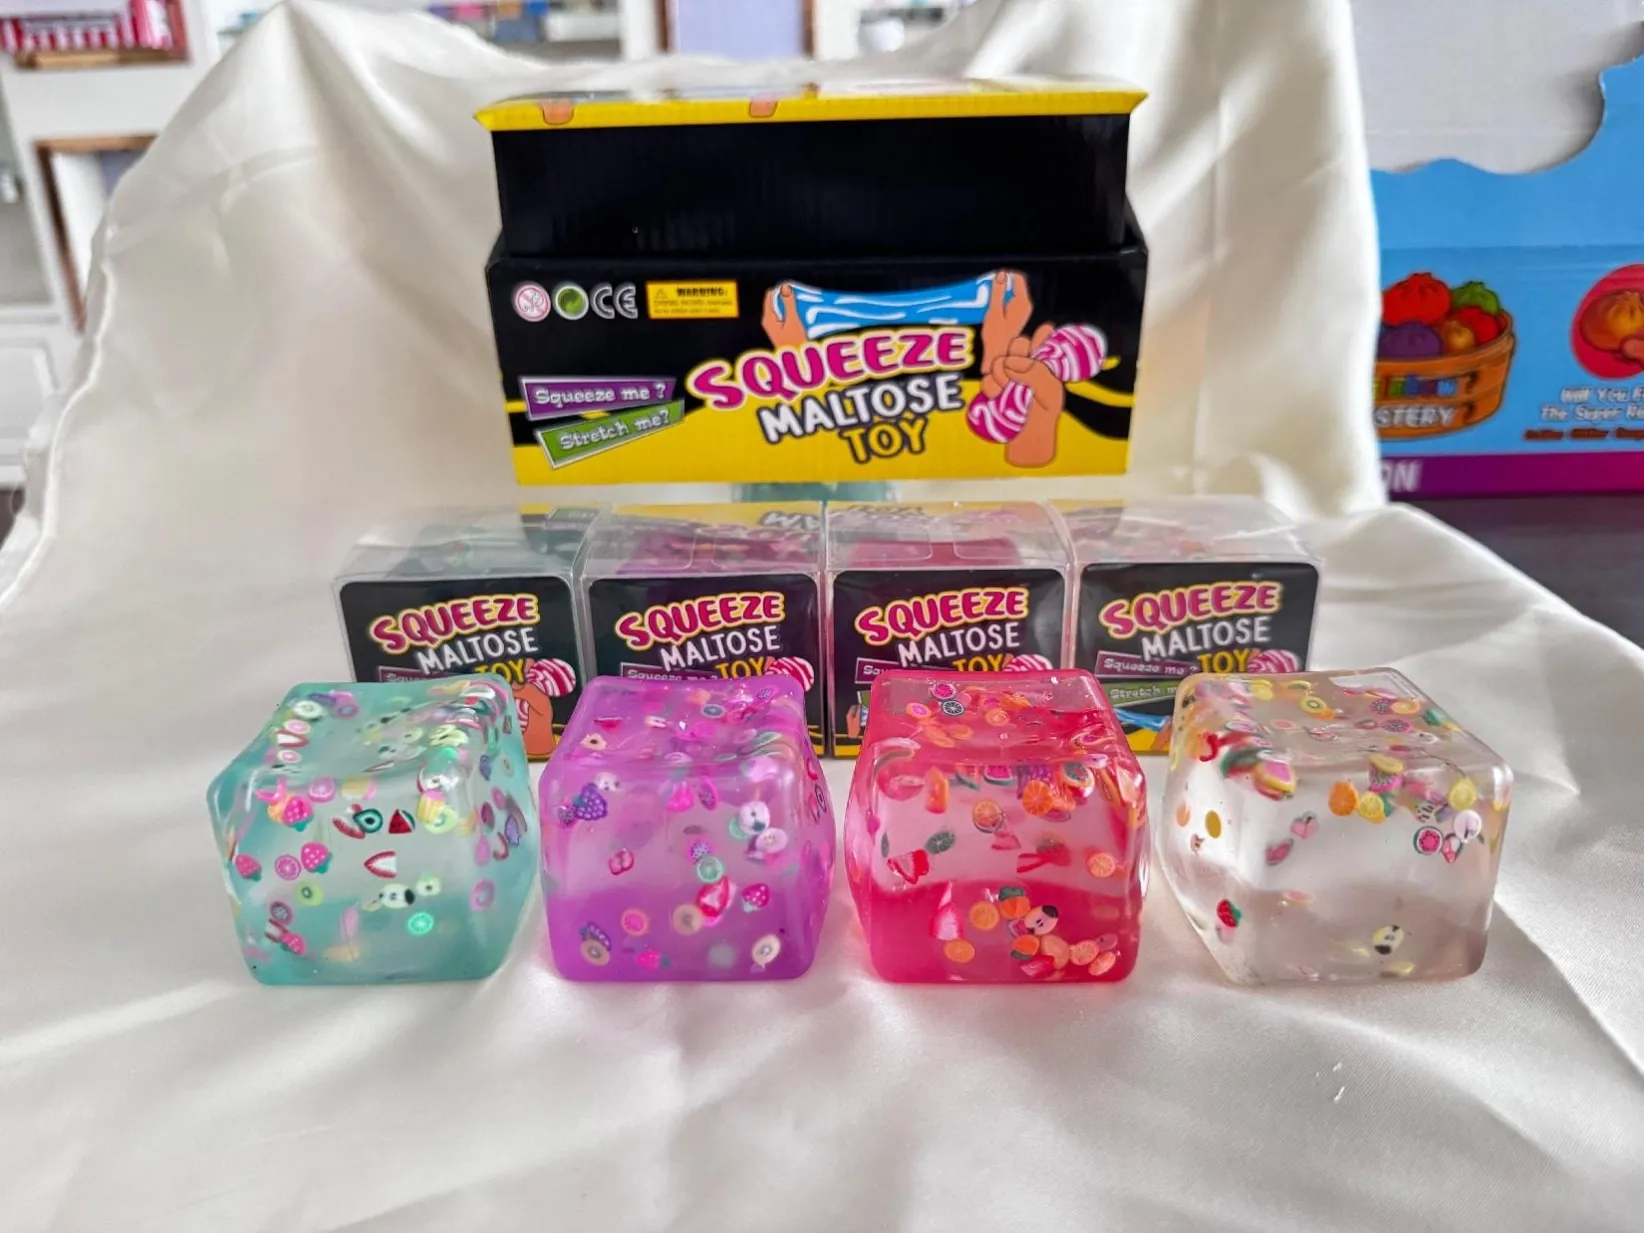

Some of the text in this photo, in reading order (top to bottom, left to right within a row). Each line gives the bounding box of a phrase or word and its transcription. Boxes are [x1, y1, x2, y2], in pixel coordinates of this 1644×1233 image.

[689, 328, 971, 410] SQUEEZE
[535, 387, 616, 408] Squeeze
[621, 387, 651, 401] me
[757, 373, 964, 444] MALTOSE
[1374, 405, 1455, 428] STERY
[560, 409, 670, 450] Stretch me?
[843, 417, 929, 463] TOY
[371, 595, 540, 653] SQUEEZE
[615, 592, 785, 651] SQUEEZE
[855, 588, 1028, 646] SQUEEZE
[1099, 582, 1281, 639] SQUEEZE
[416, 627, 538, 674] MALTOSE
[660, 625, 781, 672] MALTOSE
[898, 622, 1020, 668] MALTOSE
[1141, 616, 1271, 662] MALTOSE
[1197, 648, 1250, 673] TOY
[716, 656, 765, 680] TOY
[1103, 658, 1160, 672] Squeeze
[1110, 685, 1161, 699] Stretch
